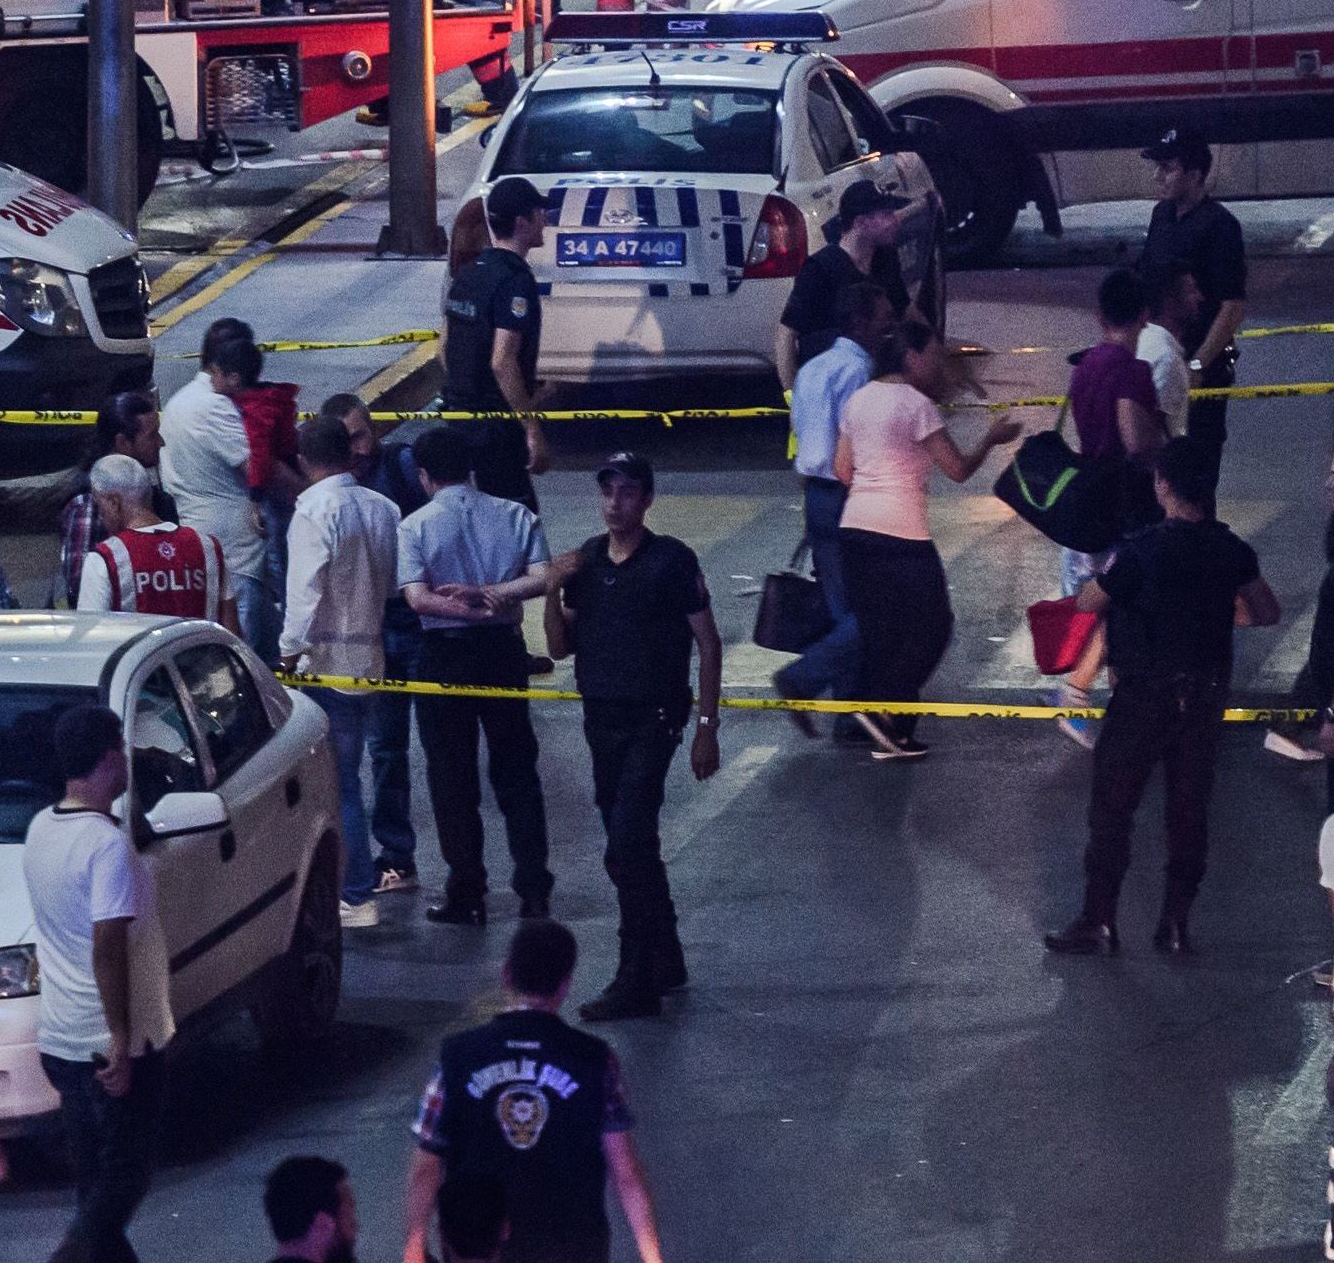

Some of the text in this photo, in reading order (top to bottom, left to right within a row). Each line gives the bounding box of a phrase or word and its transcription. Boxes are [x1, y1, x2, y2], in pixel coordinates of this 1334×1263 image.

[563, 240, 677, 256] 34 A 47440
[135, 562, 206, 594] POLİS
